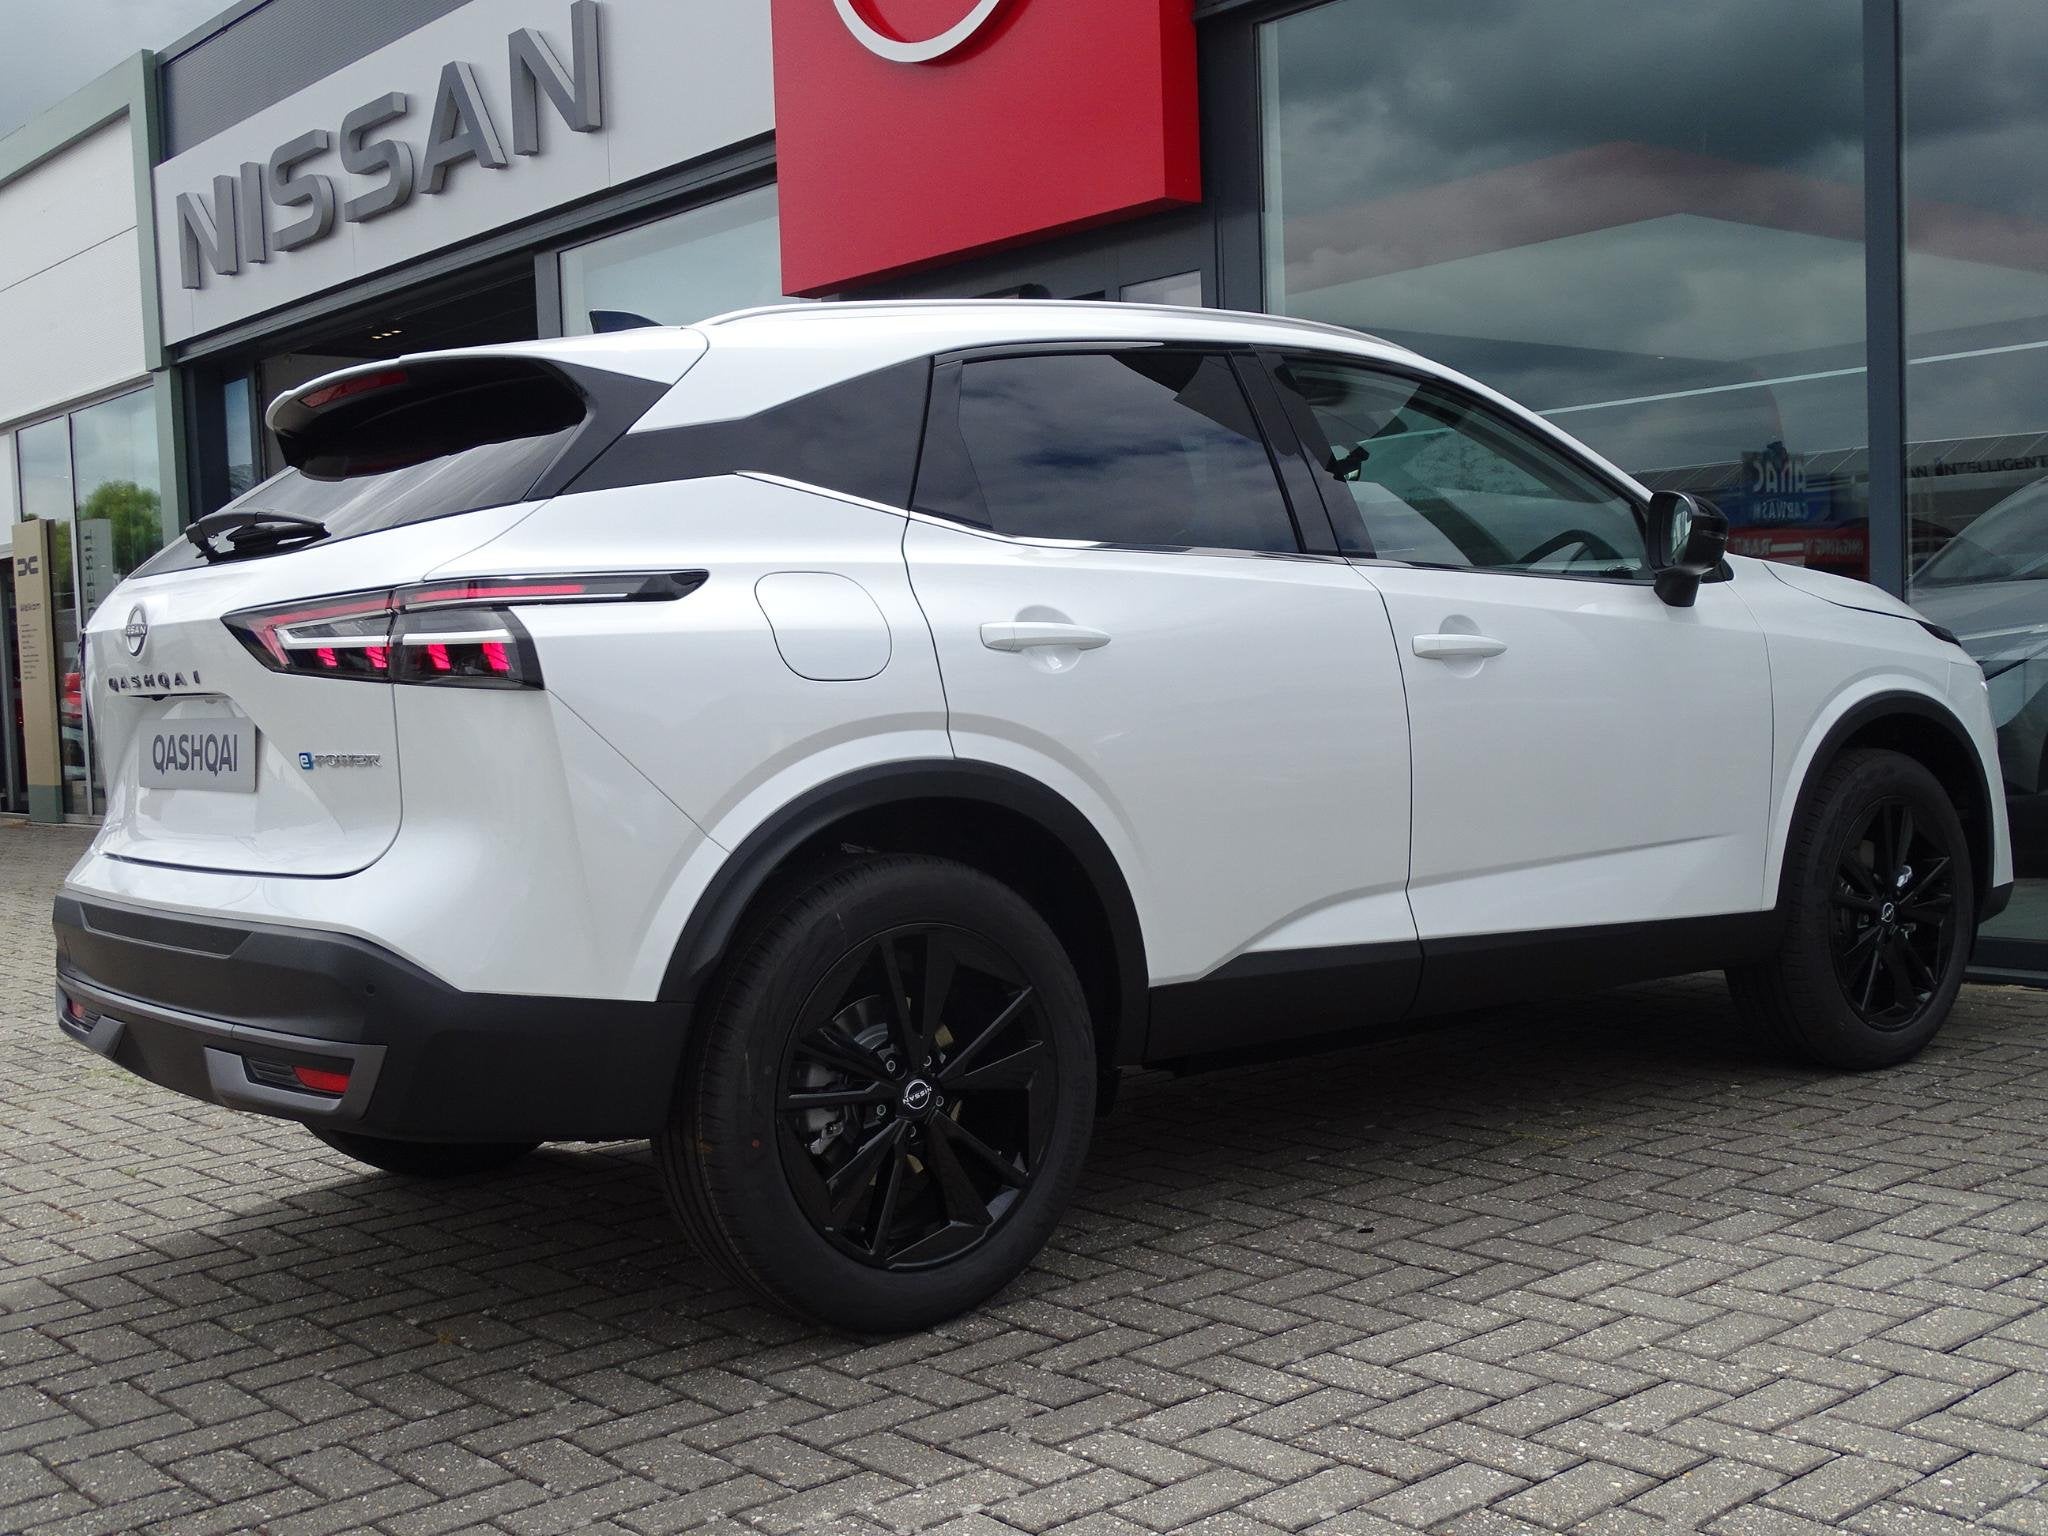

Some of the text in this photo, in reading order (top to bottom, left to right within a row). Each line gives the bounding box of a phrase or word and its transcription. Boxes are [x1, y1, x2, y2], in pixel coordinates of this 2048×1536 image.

[176, 0, 604, 289] NISSAN
[126, 624, 148, 634] SSAN
[108, 669, 201, 693] QASHQAI
[152, 733, 238, 777] QASHQAI
[902, 1086, 932, 1104] NISSAN
